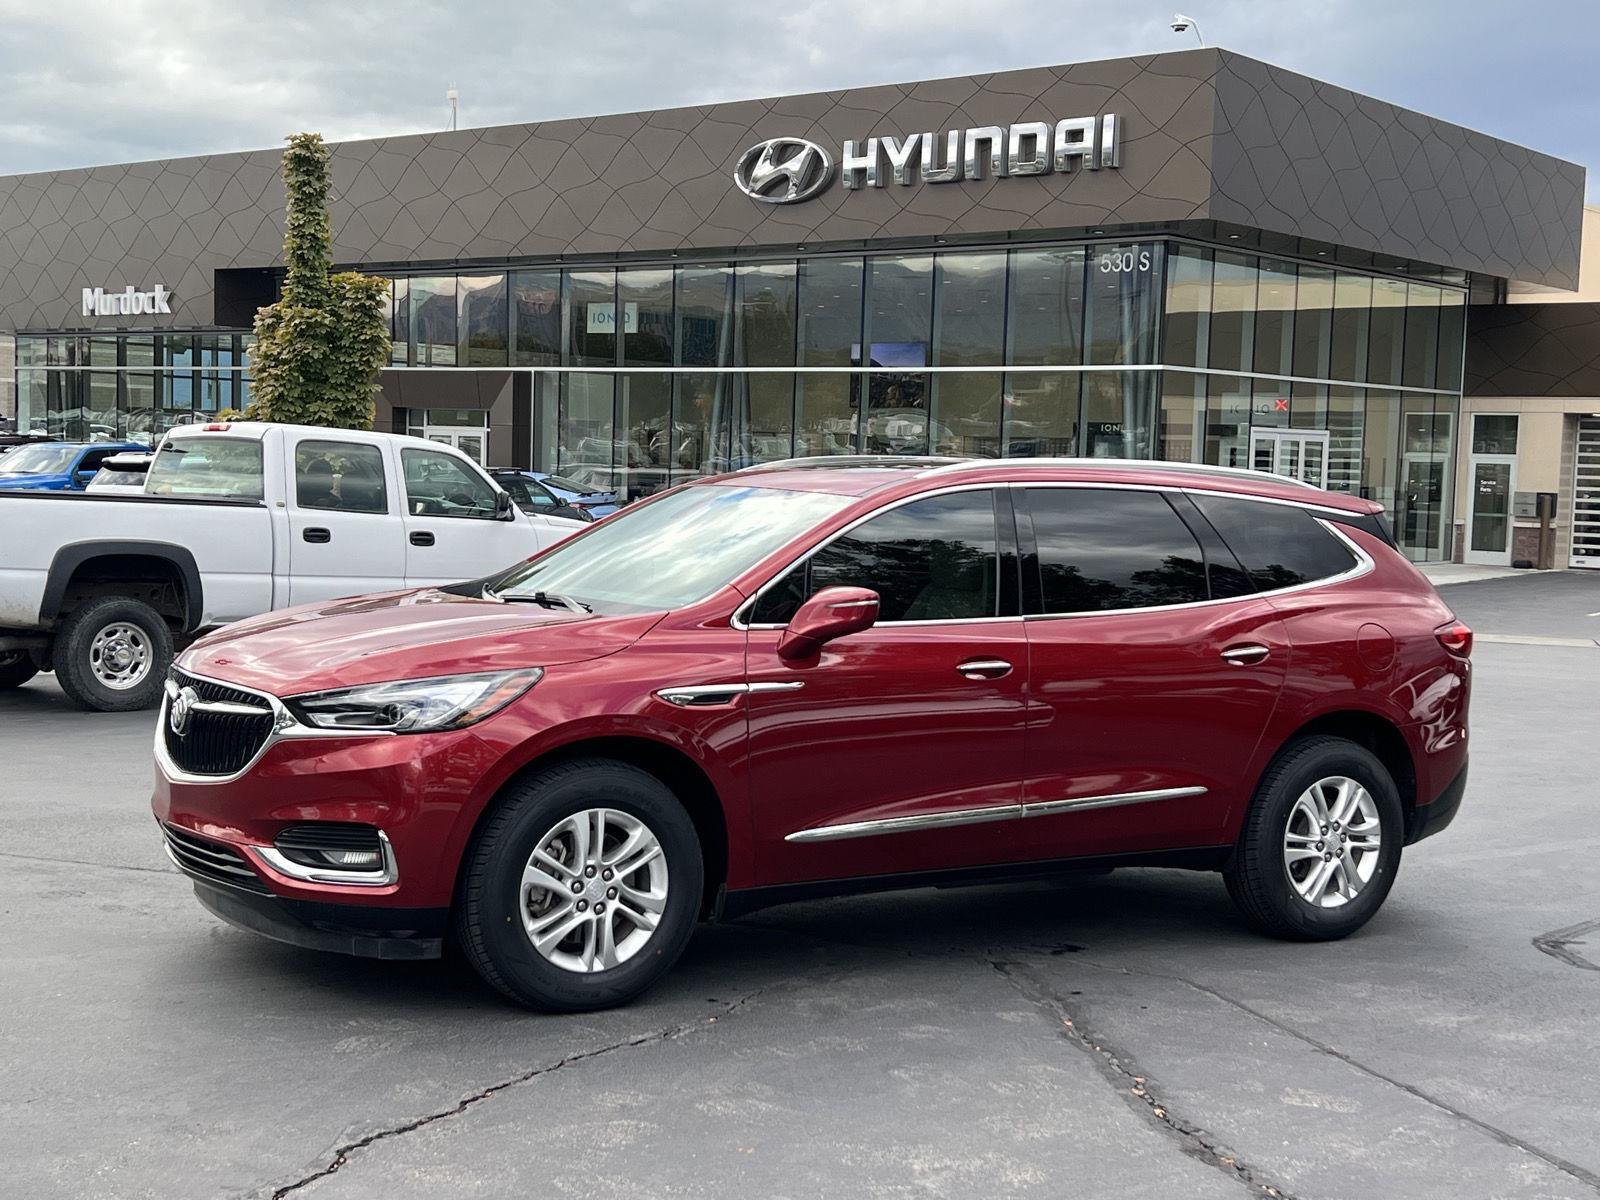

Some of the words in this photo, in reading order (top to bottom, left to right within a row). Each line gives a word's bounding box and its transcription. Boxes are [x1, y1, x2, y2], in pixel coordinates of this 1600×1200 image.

[842, 113, 1119, 190] HYUNDAI
[1100, 252, 1134, 273] 530
[1138, 251, 1150, 272] S
[82, 284, 171, 317] Murdock
